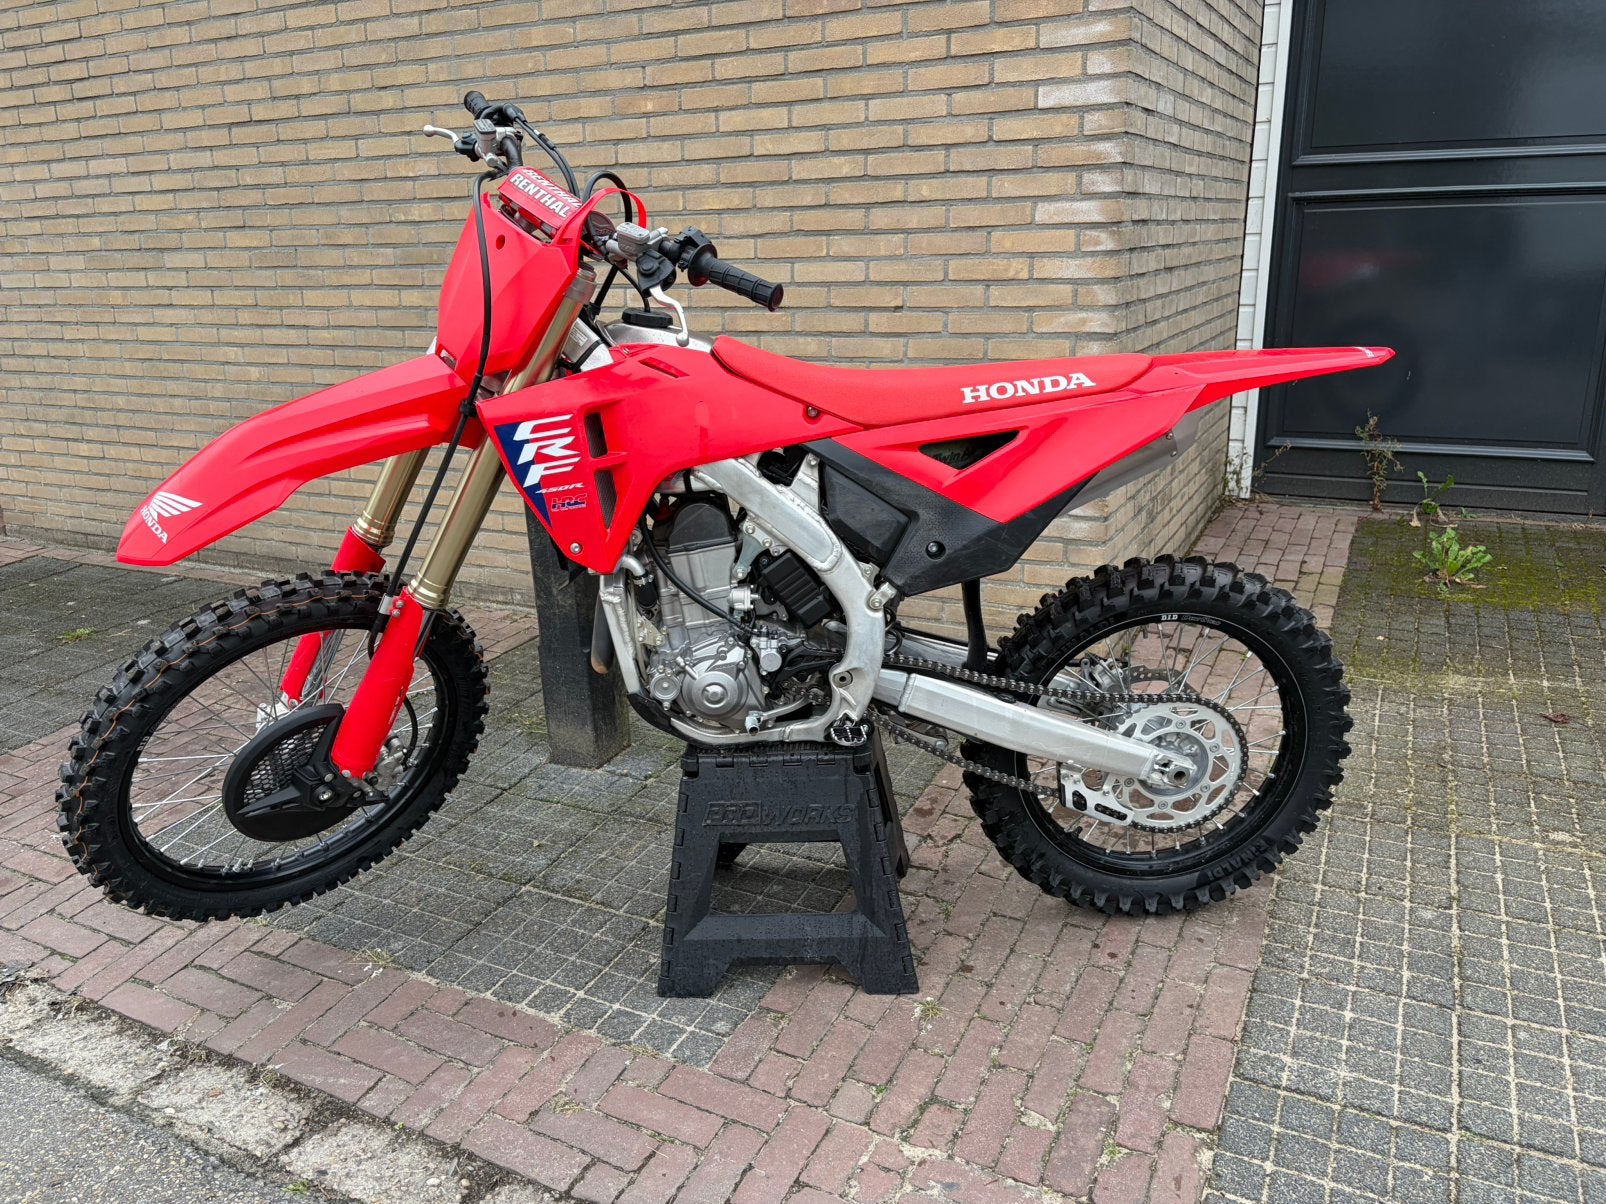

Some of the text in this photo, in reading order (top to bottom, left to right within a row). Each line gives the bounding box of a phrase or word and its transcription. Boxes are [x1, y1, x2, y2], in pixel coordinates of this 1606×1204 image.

[510, 173, 571, 218] RENTHAL
[961, 371, 1096, 404] HONDA
[513, 413, 582, 488] CRF
[535, 482, 585, 494] 450R
[551, 493, 588, 510] HRC
[139, 505, 170, 545] HONDA
